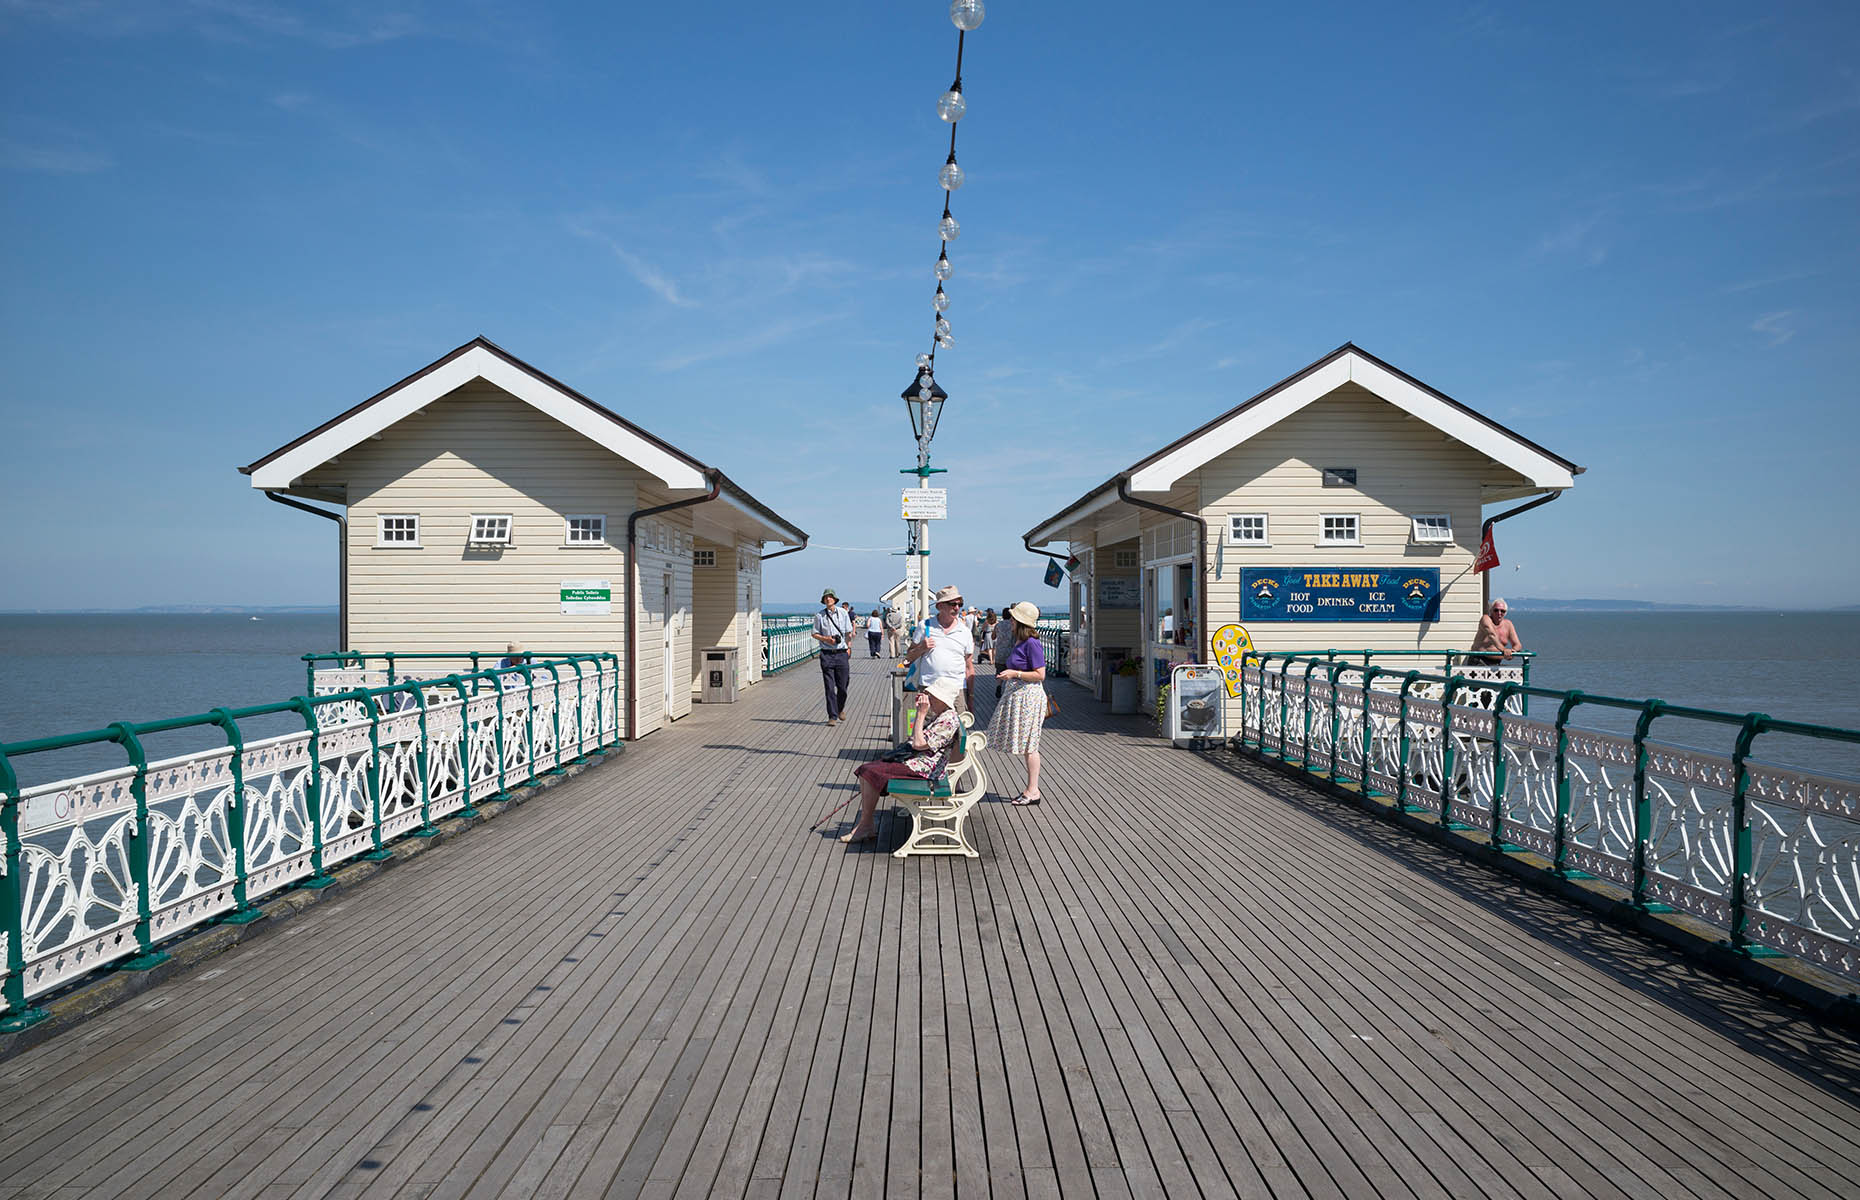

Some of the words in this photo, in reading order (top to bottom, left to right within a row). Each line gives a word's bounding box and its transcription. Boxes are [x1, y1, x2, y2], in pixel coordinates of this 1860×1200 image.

[1251, 578, 1280, 589] DECKS
[1283, 575, 1302, 587] Good
[1303, 574, 1340, 588] TAKE
[1341, 574, 1380, 588] AWAY
[1379, 574, 1401, 585] Food
[1402, 578, 1431, 589] DECKS
[1290, 592, 1310, 601] HOT
[1369, 592, 1386, 601] ICE
[1317, 597, 1355, 607] DRINKS
[1287, 604, 1314, 613] FOOD
[1359, 603, 1395, 613] CREAM
